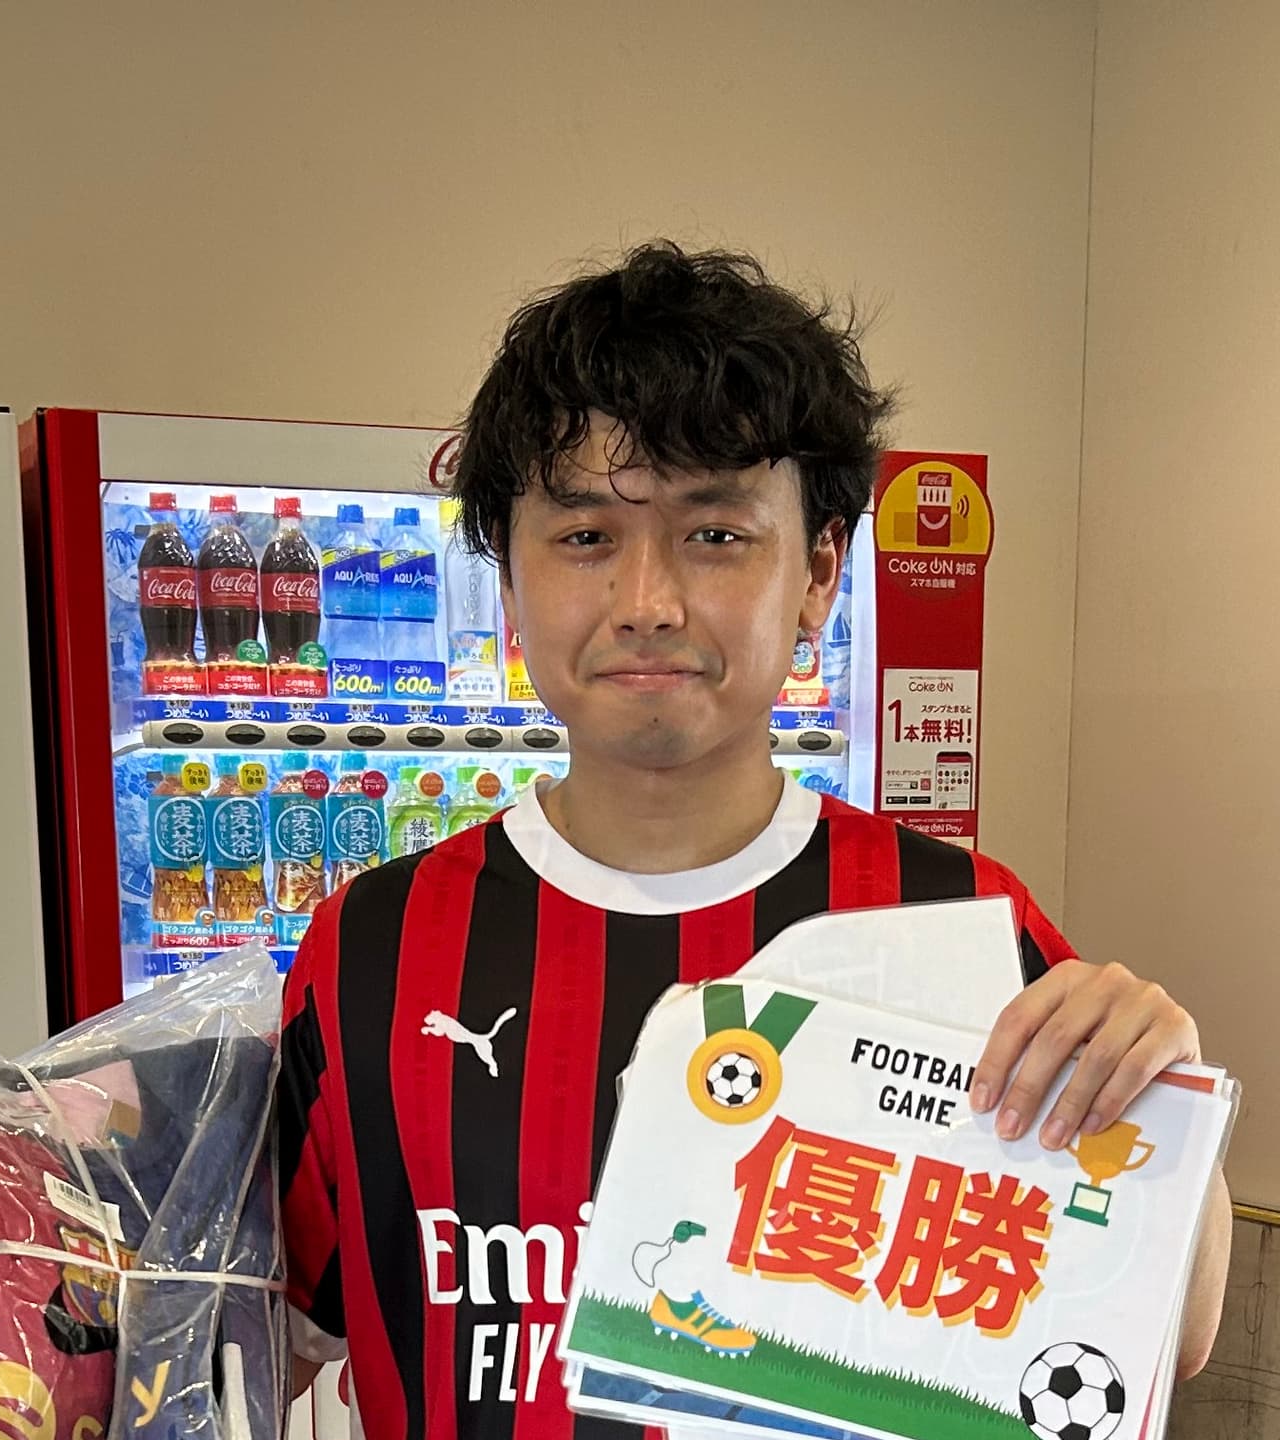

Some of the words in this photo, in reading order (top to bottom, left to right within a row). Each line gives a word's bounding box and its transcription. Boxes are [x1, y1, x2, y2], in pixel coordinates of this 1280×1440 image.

[888, 558, 927, 574] Coke
[930, 557, 954, 575] ON
[955, 563, 976, 576] 対応
[148, 578, 195, 600] Coca-Cola
[211, 572, 256, 593] Coca-Cola
[273, 574, 318, 597] Coca-Cola
[394, 664, 421, 674] たっぷり
[334, 676, 384, 694] 600ml
[394, 676, 443, 695] 600ml
[909, 681, 936, 692] Coke
[937, 680, 954, 692] ON
[888, 698, 972, 743] 1本無料!
[921, 704, 972, 714] スタンプたまると
[172, 803, 196, 855] 麦茶
[230, 803, 254, 856] 麦茶
[291, 812, 314, 852] 麦茶
[349, 812, 371, 853] 麦茶
[946, 825, 963, 835] Pay
[879, 1085, 956, 1127] GAME
[726, 1114, 1054, 1340] 優勝
[416, 1201, 593, 1304] Emi
[469, 1323, 556, 1402] FLY
[131, 1360, 171, 1428] y
